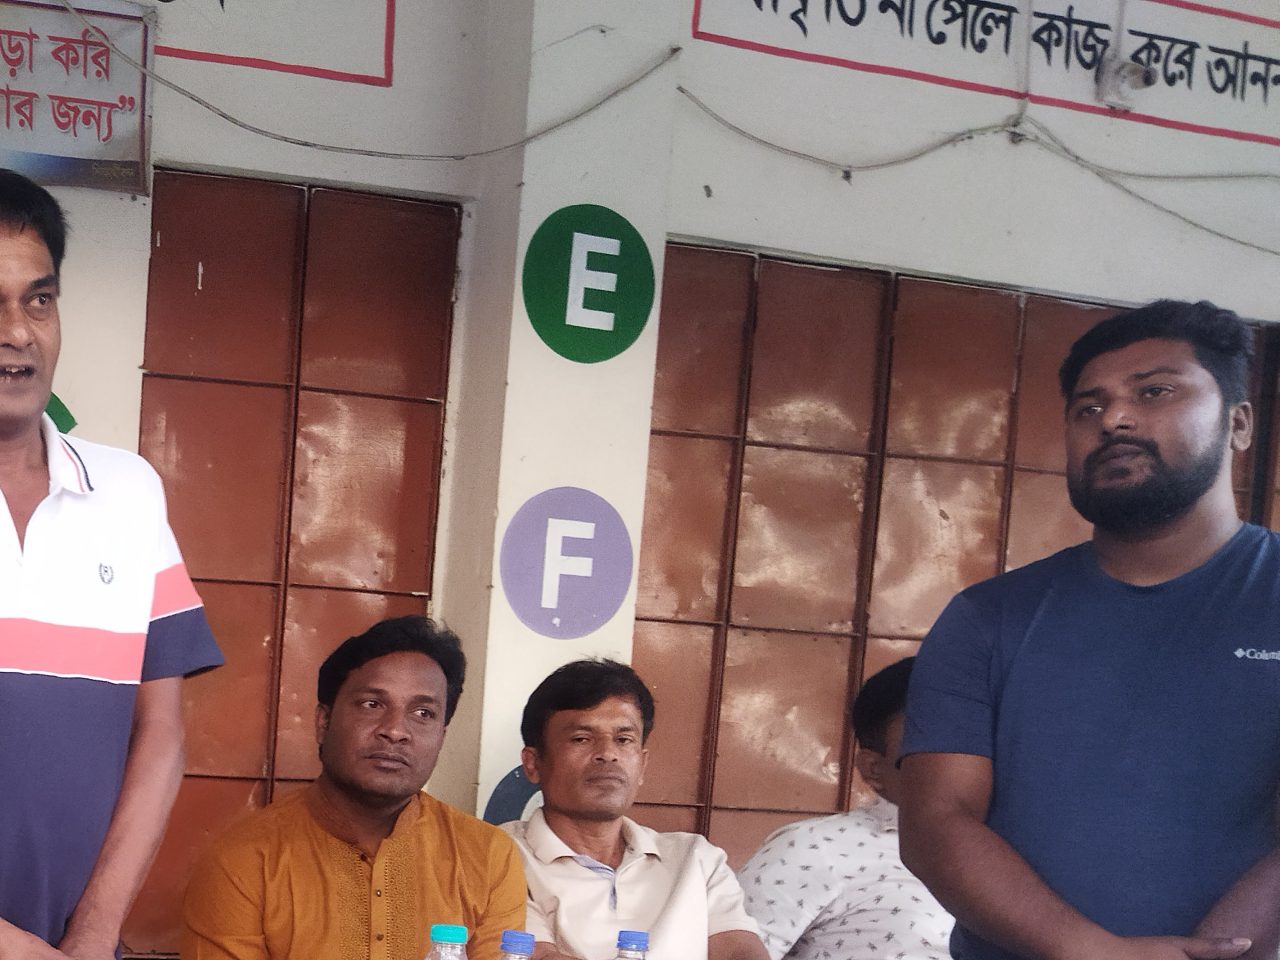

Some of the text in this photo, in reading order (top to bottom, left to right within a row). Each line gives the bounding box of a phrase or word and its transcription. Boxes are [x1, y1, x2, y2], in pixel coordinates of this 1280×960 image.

[47, 25, 111, 80] করি
[926, 0, 1019, 54] পেলে
[1032, 5, 1111, 88] কাজ
[1127, 29, 1200, 90] করে
[565, 231, 621, 332] E
[540, 517, 596, 609] F
